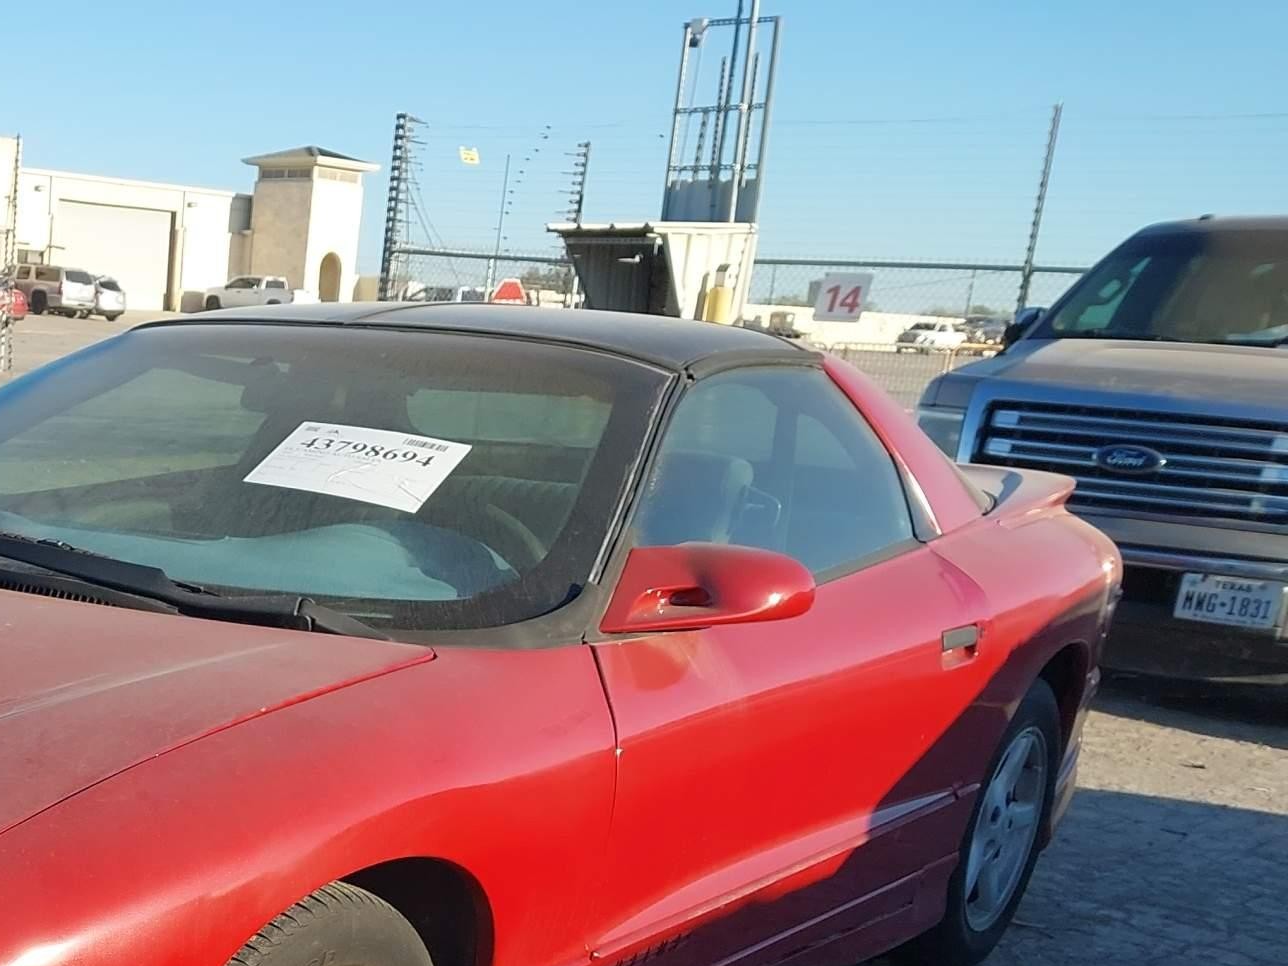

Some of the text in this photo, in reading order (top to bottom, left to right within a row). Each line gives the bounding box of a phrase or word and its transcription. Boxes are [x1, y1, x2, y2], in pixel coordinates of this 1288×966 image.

[826, 284, 862, 314] 14
[298, 437, 436, 468] 43798694
[1107, 447, 1148, 468] Ford
